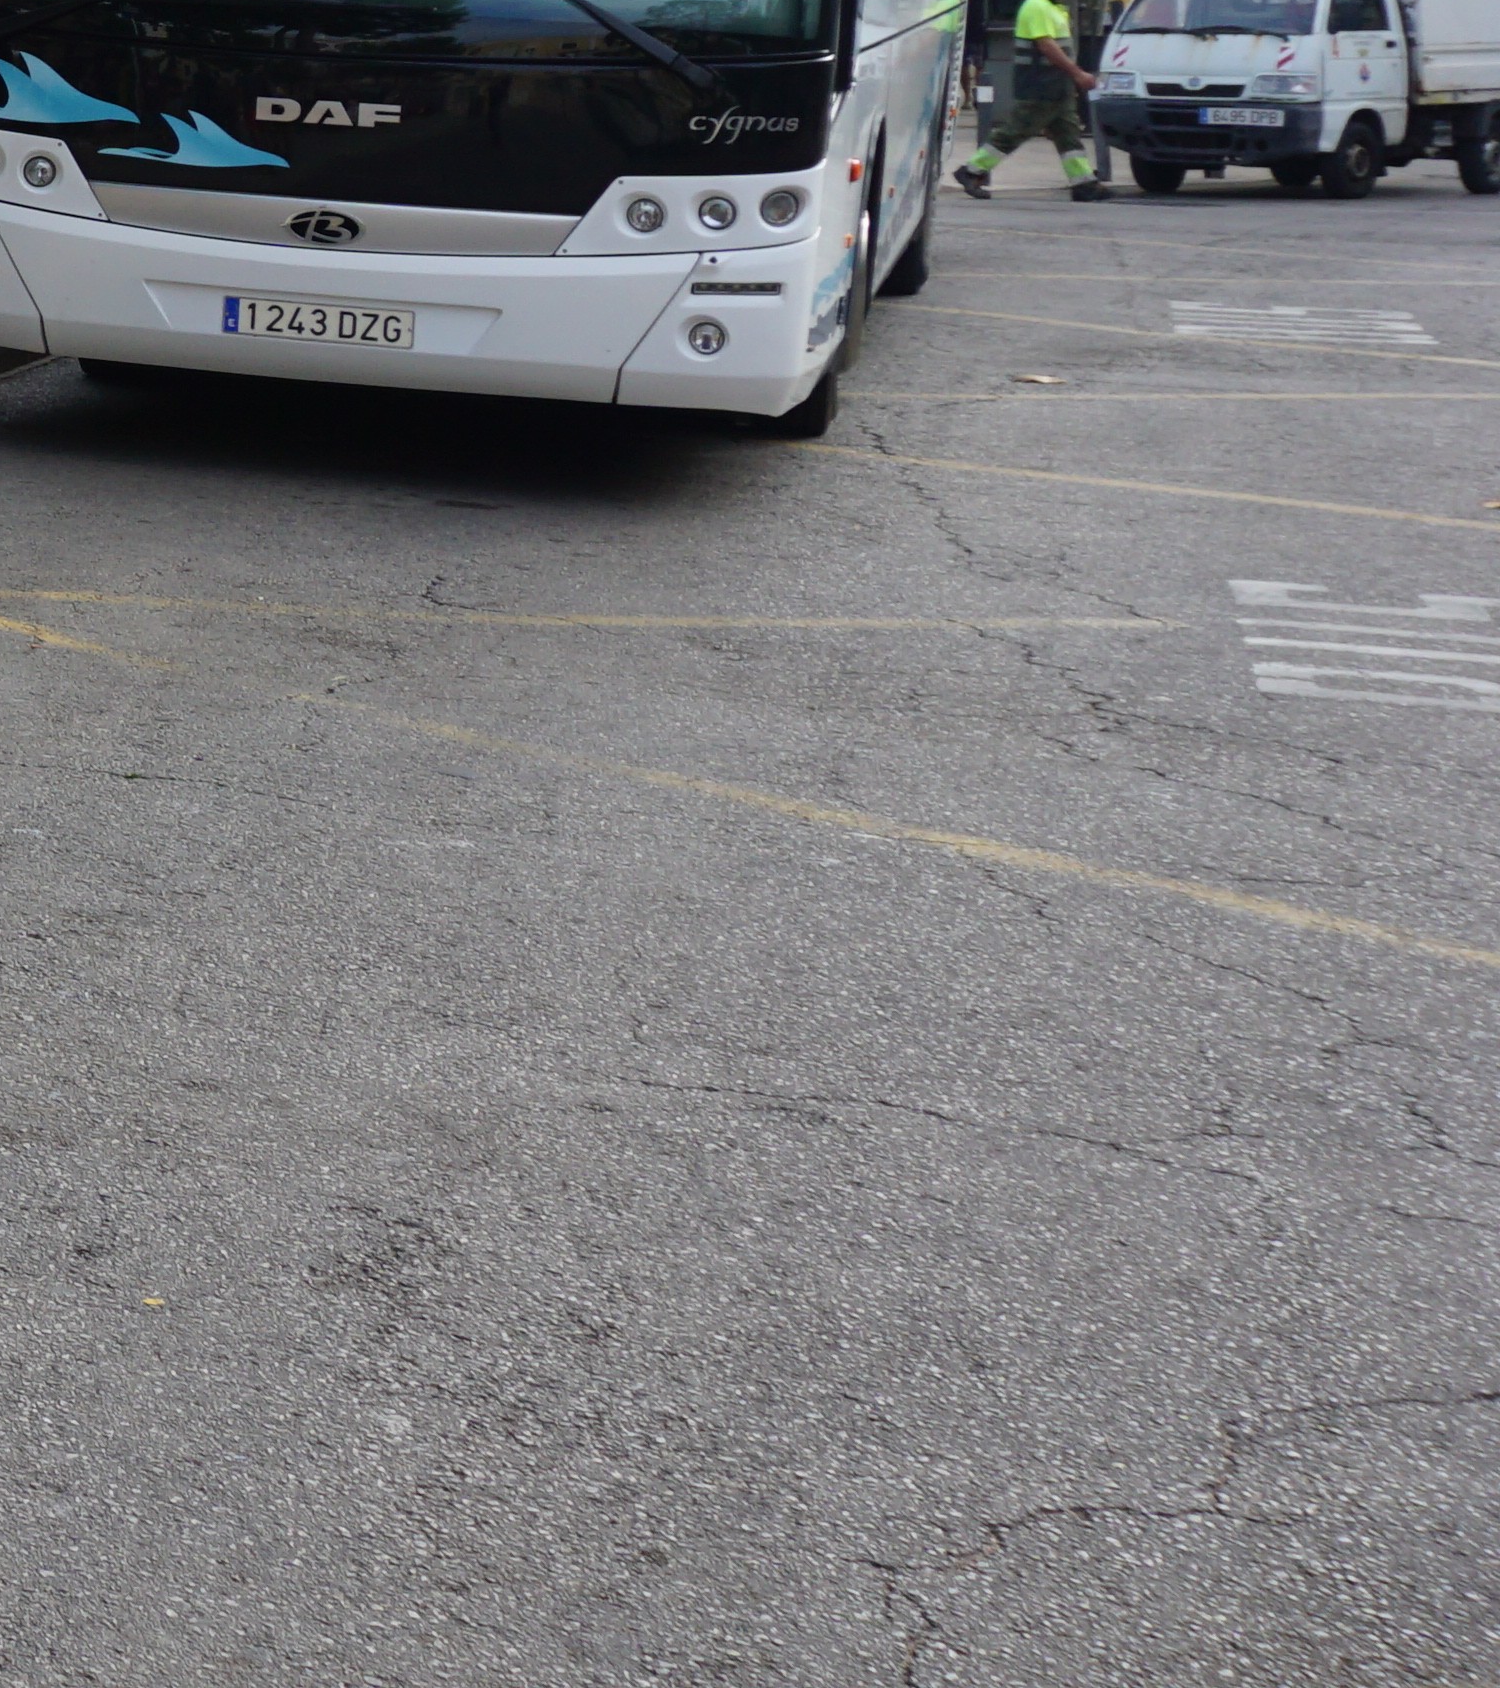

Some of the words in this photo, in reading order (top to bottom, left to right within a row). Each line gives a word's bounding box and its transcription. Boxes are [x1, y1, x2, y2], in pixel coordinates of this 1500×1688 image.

[255, 96, 402, 128] DAF
[688, 105, 800, 145] cygnus
[247, 302, 328, 336] 1243
[338, 311, 402, 343] DZG
